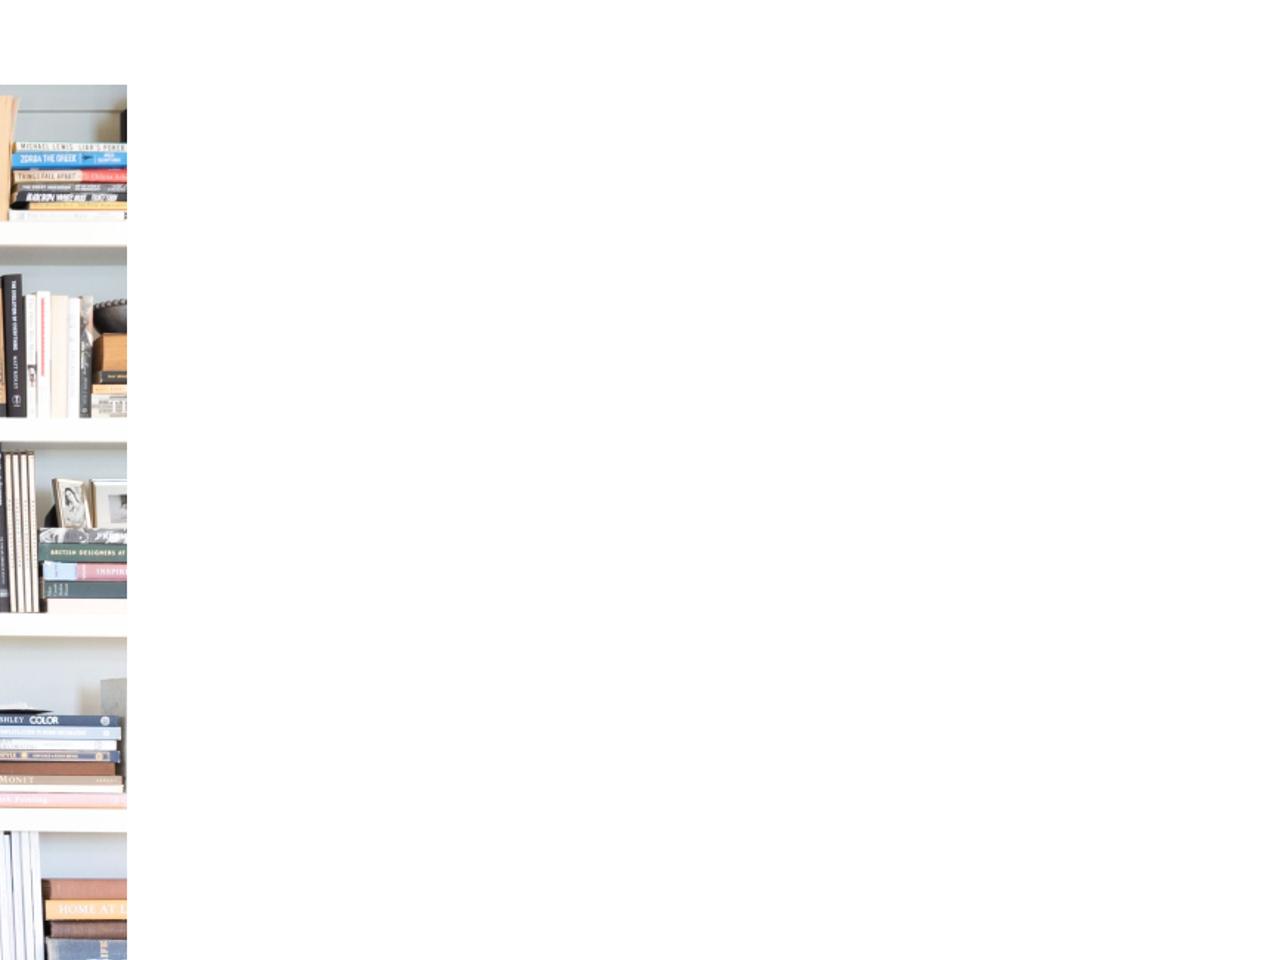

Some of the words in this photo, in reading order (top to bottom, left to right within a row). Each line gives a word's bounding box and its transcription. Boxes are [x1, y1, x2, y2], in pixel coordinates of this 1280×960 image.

[20, 154, 42, 163] ZORBA
[43, 154, 54, 162] THE
[56, 154, 76, 163] GREEK
[58, 903, 95, 914] HOME
